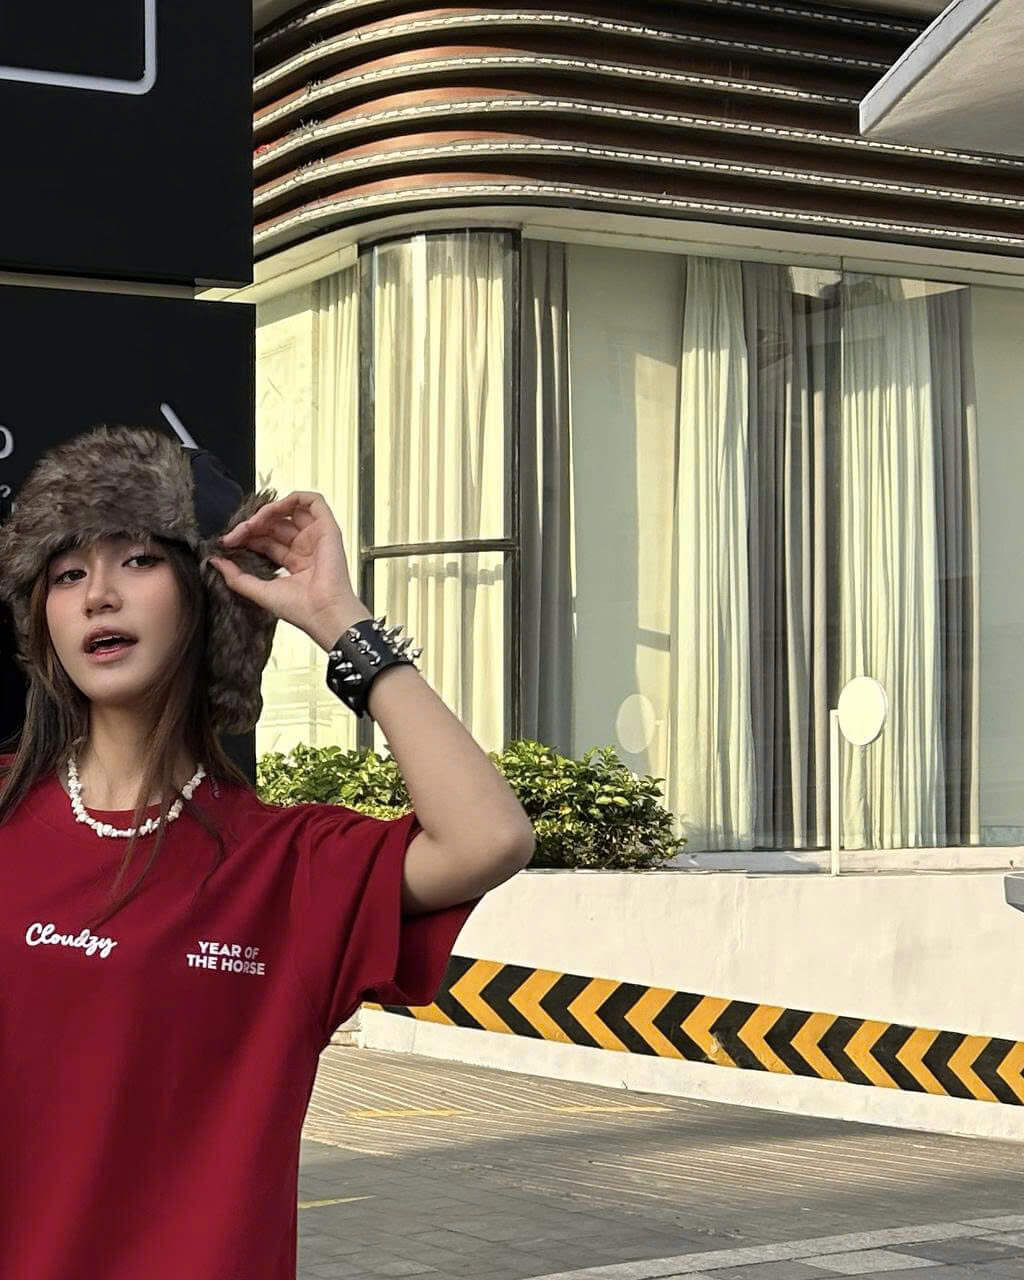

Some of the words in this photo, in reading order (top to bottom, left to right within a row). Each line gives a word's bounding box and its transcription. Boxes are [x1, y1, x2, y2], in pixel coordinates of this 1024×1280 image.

[25, 922, 118, 959] Cloudzy
[198, 940, 242, 958] YEAR
[244, 946, 260, 960] OF
[186, 953, 218, 970] THE
[221, 957, 266, 976] HORSE
